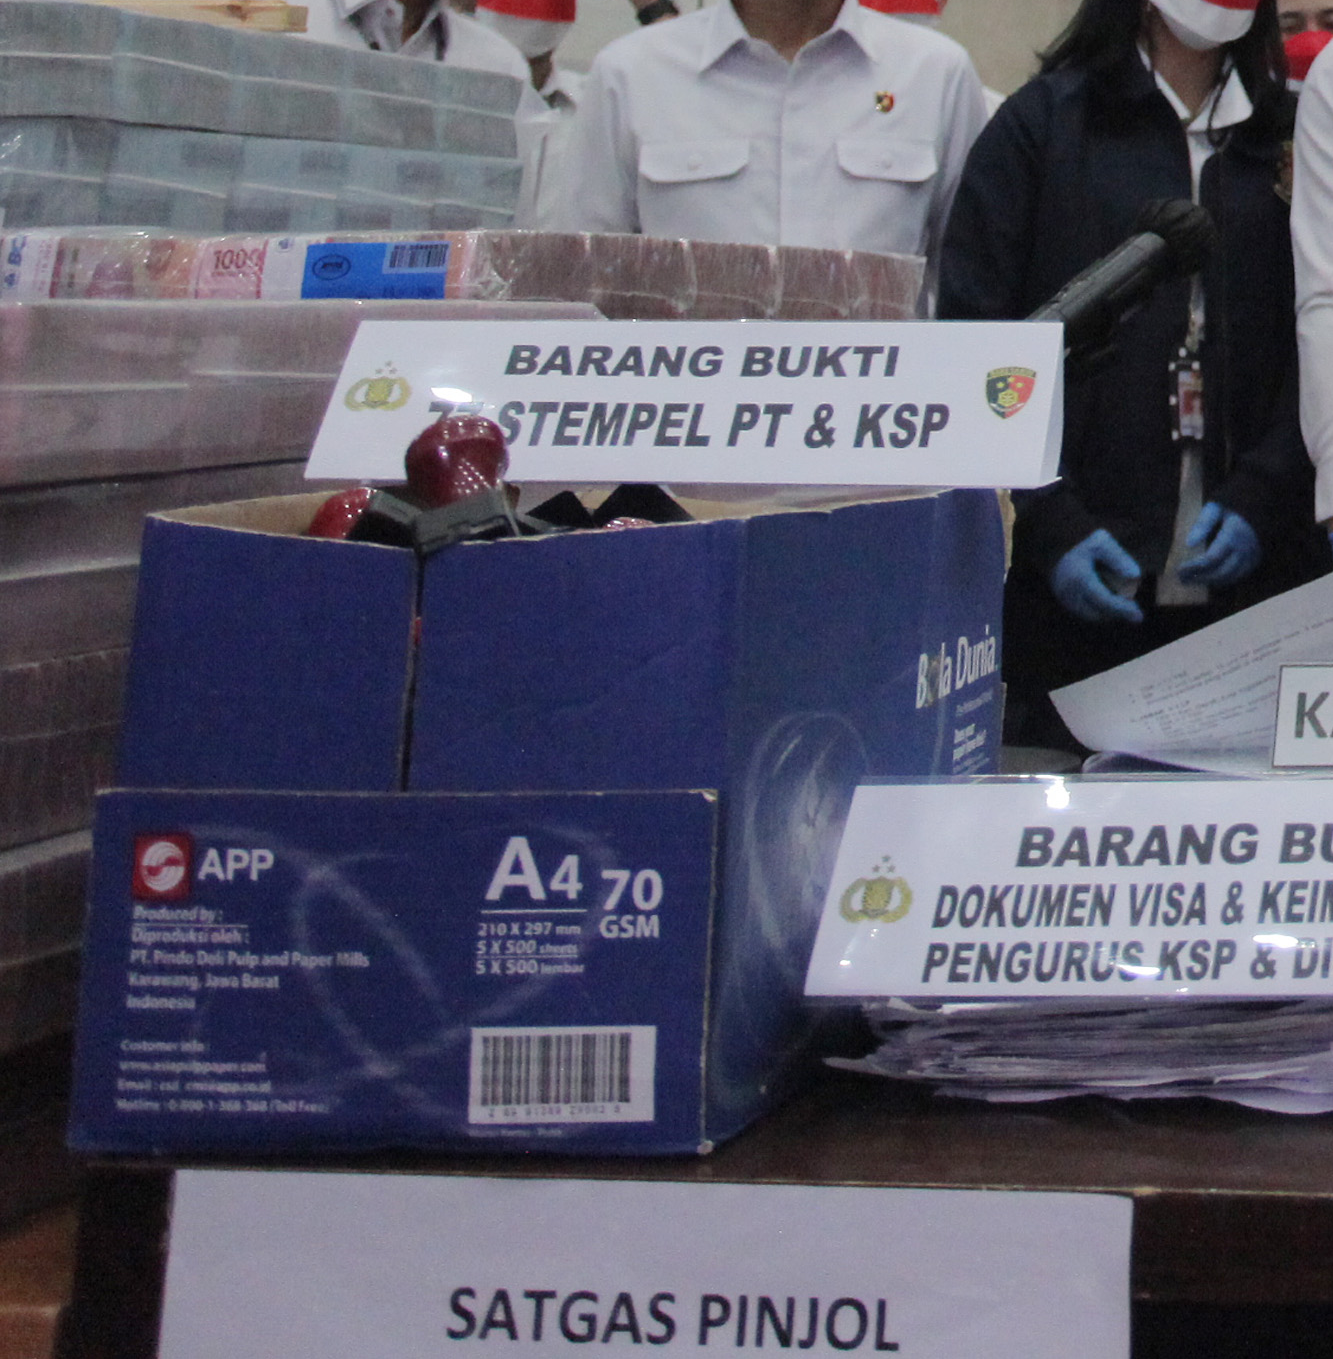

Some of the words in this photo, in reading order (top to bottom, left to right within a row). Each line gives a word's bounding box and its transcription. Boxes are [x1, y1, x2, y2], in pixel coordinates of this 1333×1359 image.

[504, 344, 724, 377] BARANG
[740, 346, 900, 377] BUKTI
[498, 400, 711, 447] STEMPEL
[726, 403, 793, 447] PT
[803, 403, 837, 449] &
[852, 402, 950, 449] KSP
[955, 624, 997, 690] Dunia
[199, 848, 275, 882] APP
[1016, 824, 1259, 868] BARANG
[485, 836, 583, 901] A4
[601, 869, 664, 911] 70
[932, 885, 1116, 929] DOKUMEN
[1128, 883, 1209, 928] VISA
[1220, 882, 1245, 926] &
[478, 922, 507, 937] 210
[524, 922, 553, 936] 297
[555, 925, 581, 936] mm
[599, 914, 660, 939] GSM
[261, 950, 290, 966] and
[292, 951, 334, 970] Paper
[336, 951, 371, 967] Mills
[506, 940, 537, 954] 500
[921, 941, 1143, 984] PENGURUS
[1157, 940, 1237, 984] KSP
[1249, 939, 1278, 982] &
[506, 960, 538, 974] 500
[446, 1287, 677, 1346] SATGAS
[697, 1294, 901, 1353] PINJOL
